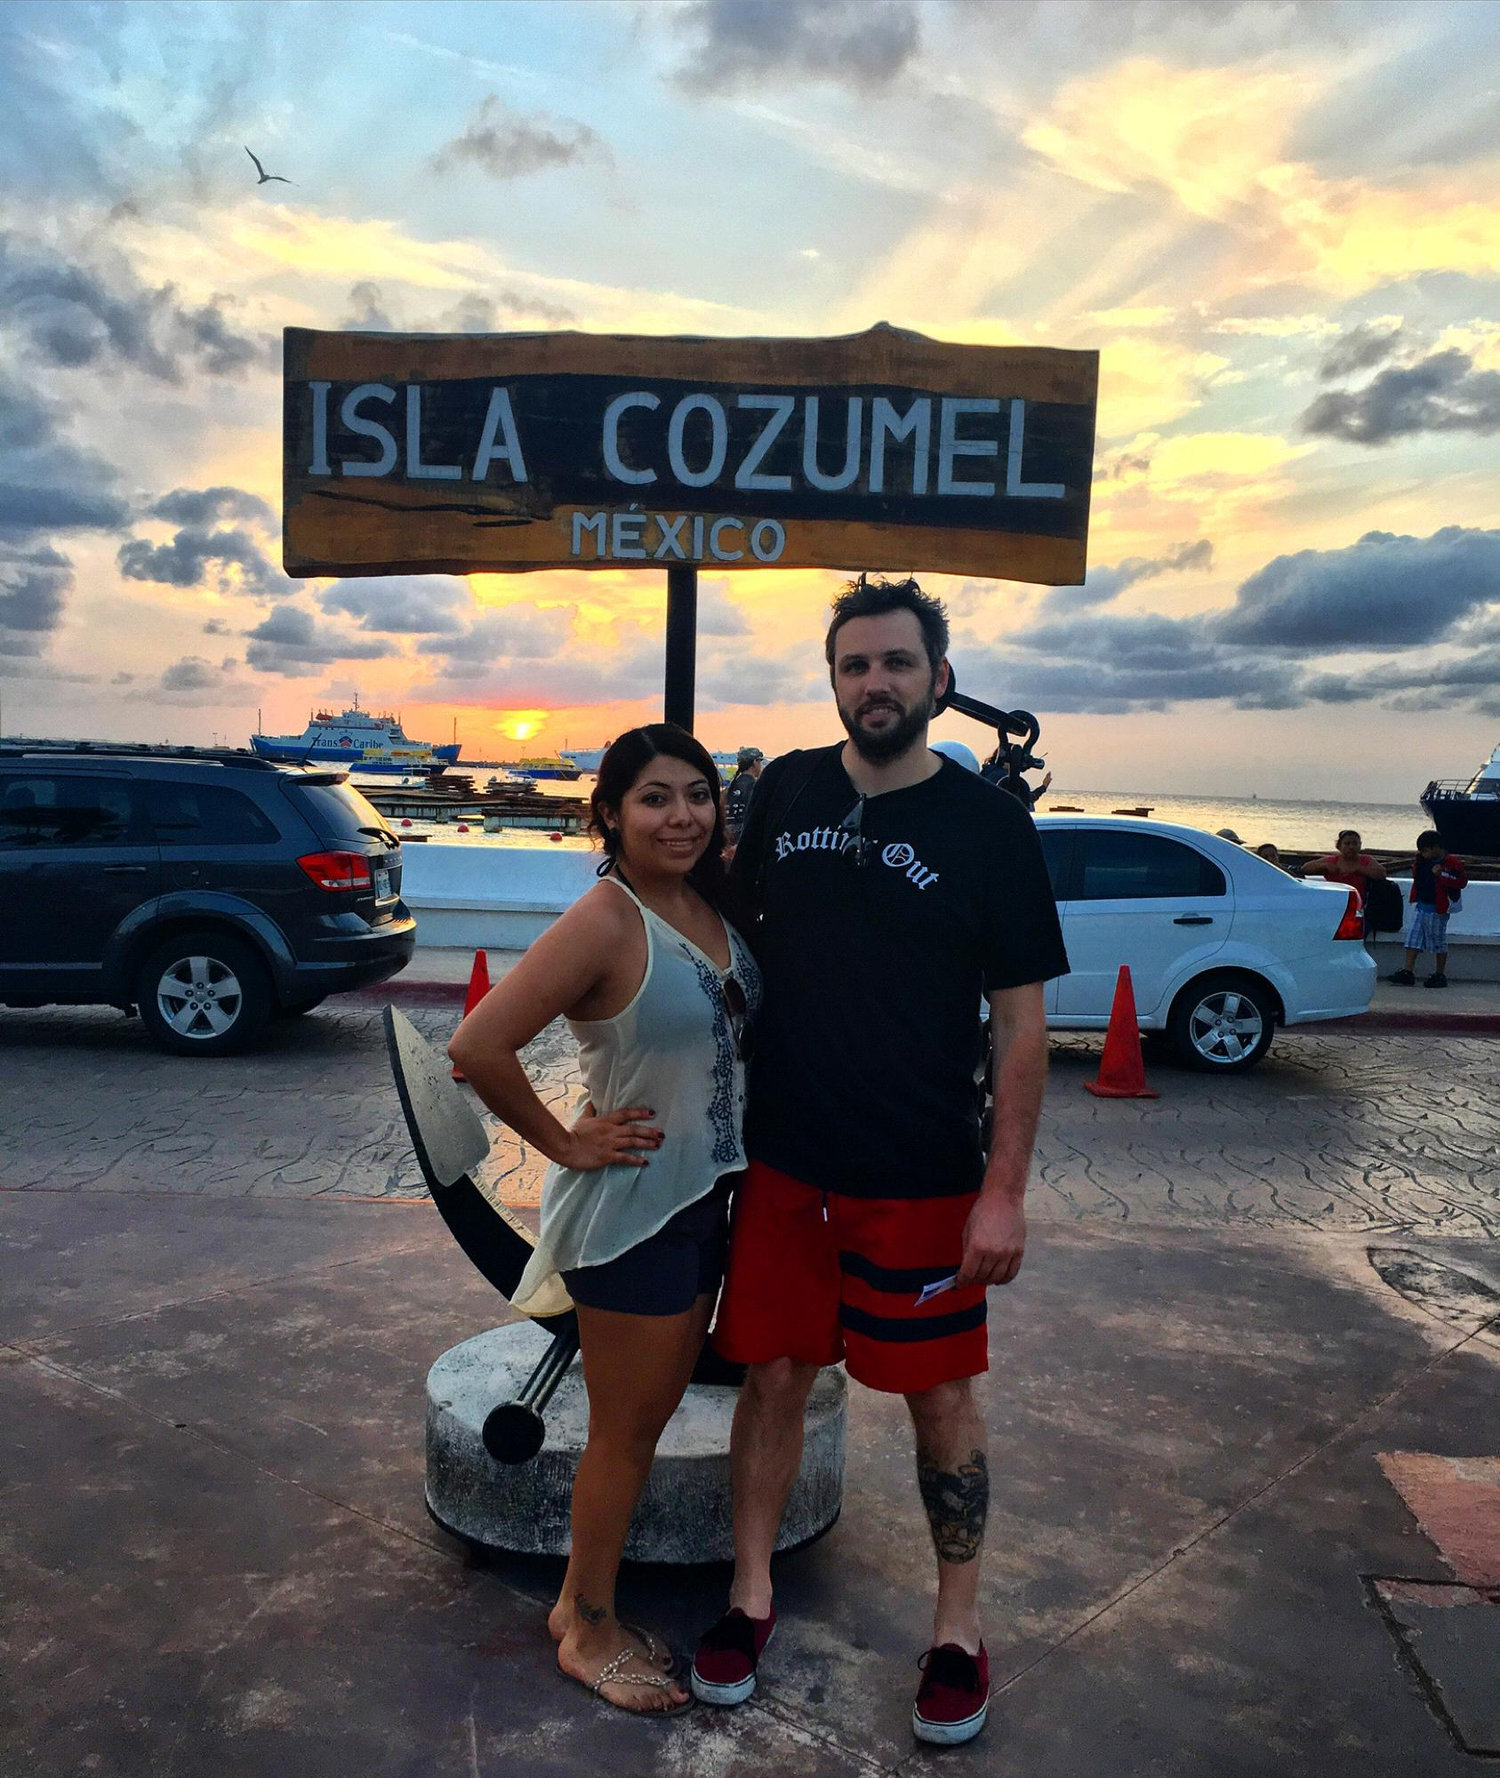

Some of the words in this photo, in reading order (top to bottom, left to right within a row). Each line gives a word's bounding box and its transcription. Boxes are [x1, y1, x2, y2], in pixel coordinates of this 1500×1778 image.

[308, 380, 529, 483] ISLA
[602, 391, 1066, 498] COZUMEL
[571, 503, 786, 562] MÉXICO
[312, 736, 338, 747] Trans
[353, 738, 384, 749] Caribe
[881, 842, 940, 890] Out
